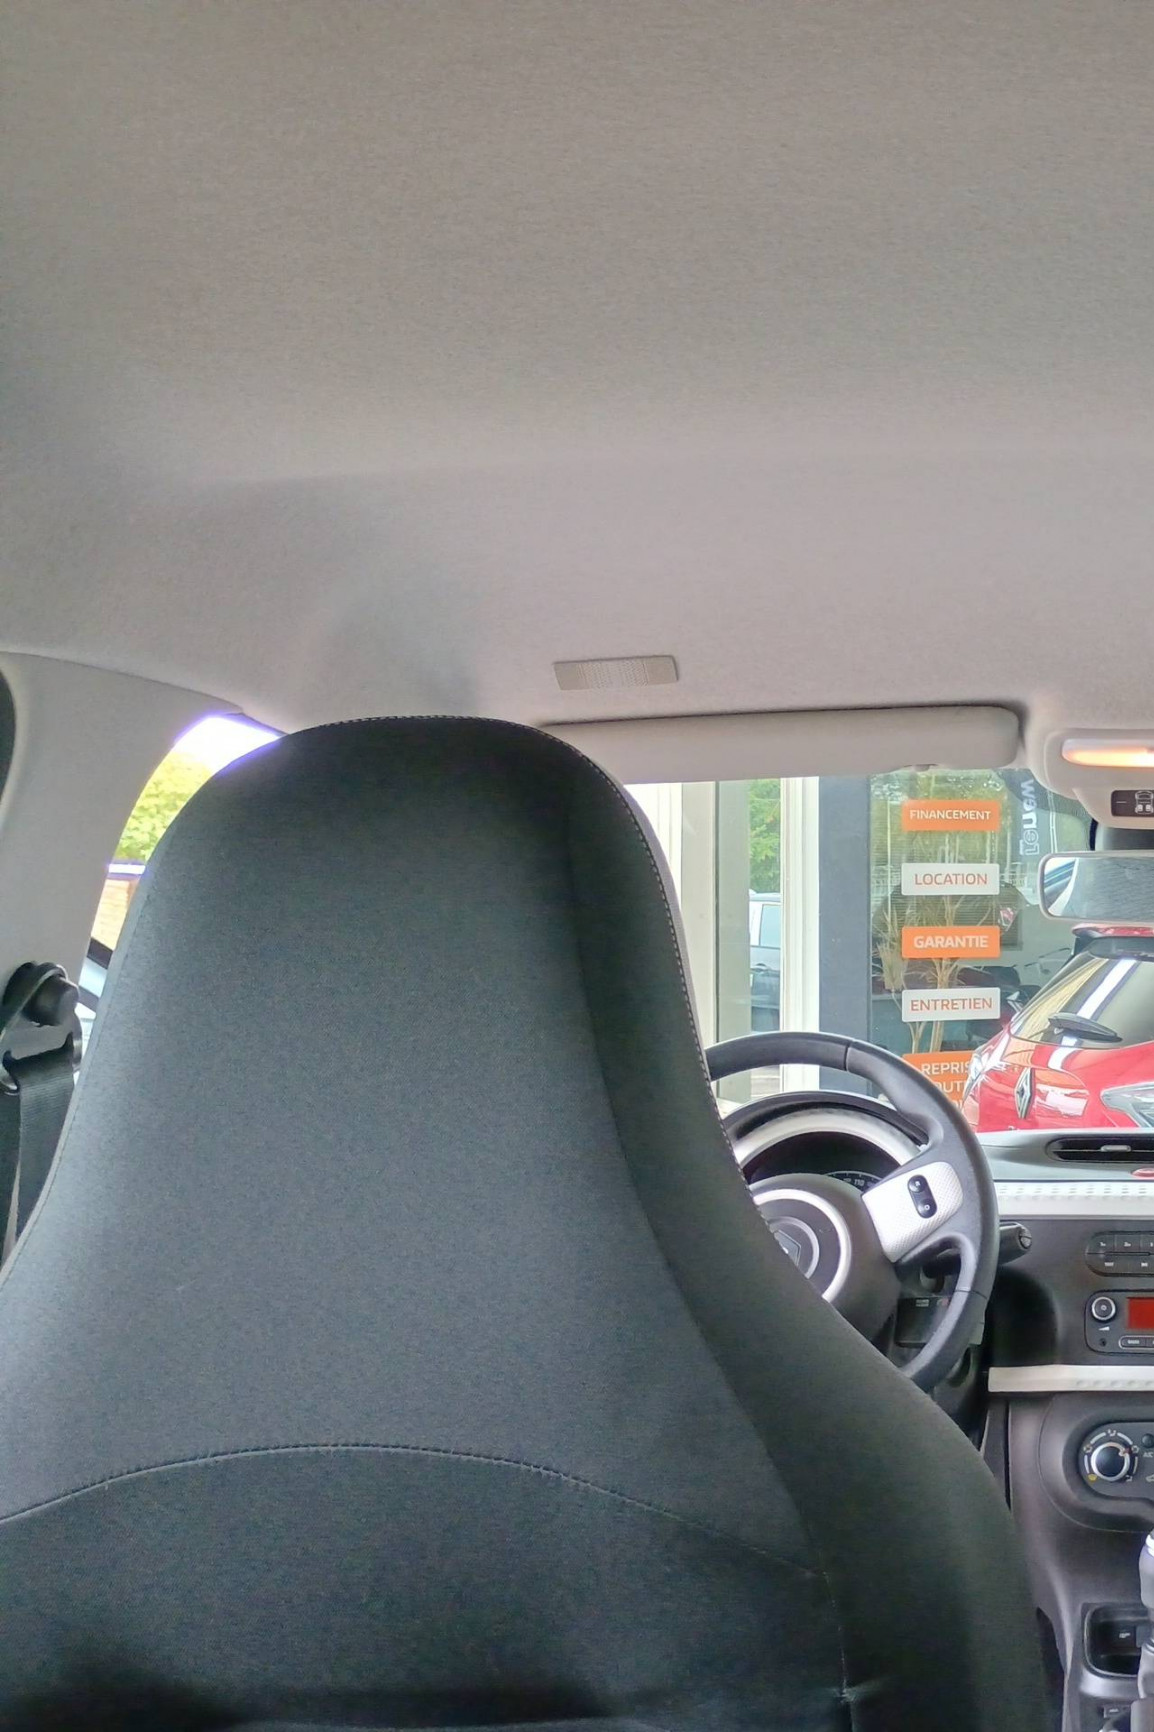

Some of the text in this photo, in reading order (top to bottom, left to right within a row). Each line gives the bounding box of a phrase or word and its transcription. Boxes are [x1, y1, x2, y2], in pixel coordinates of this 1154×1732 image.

[909, 809, 991, 820] FINANCEMENT
[915, 873, 988, 886] LOCATION
[914, 935, 989, 949] GARANTIE
[910, 997, 993, 1012] ENTRETIEN
